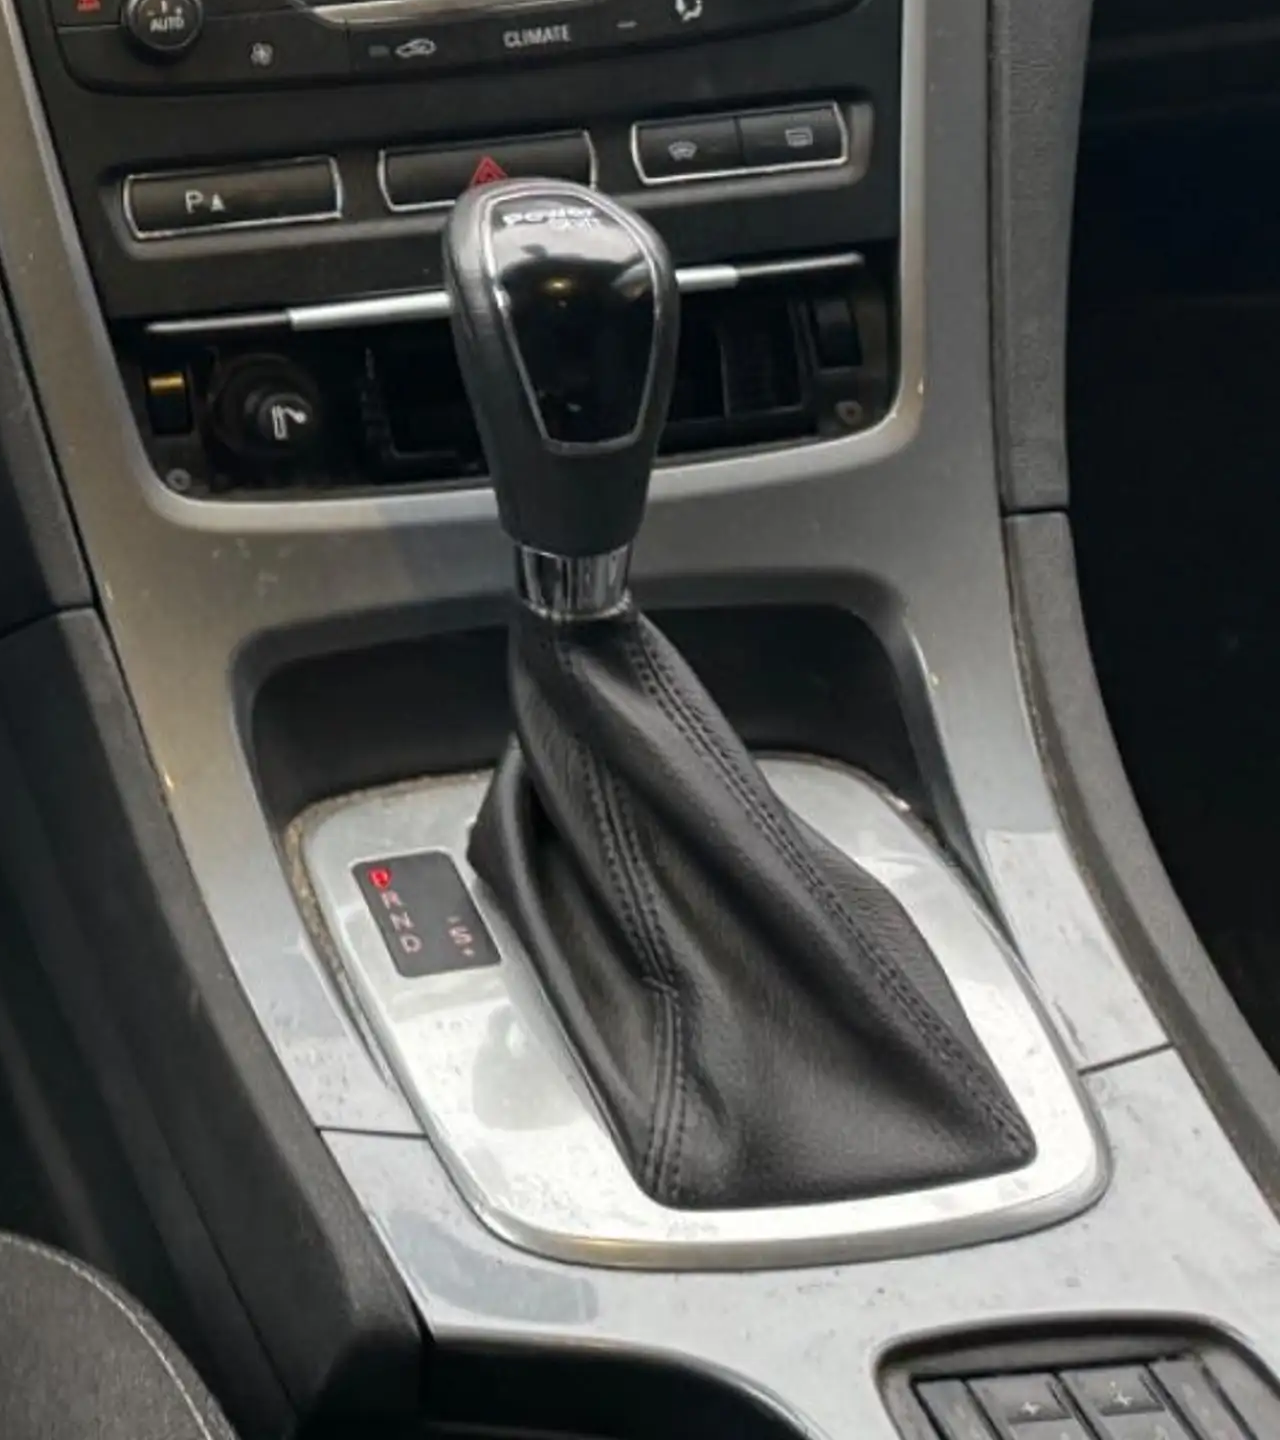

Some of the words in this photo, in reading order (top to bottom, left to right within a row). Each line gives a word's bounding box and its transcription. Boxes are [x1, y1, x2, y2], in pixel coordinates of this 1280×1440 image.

[150, 16, 185, 33] AUTO
[504, 23, 572, 49] CLIMATE
[400, 933, 423, 954] D
[448, 926, 474, 946] S
